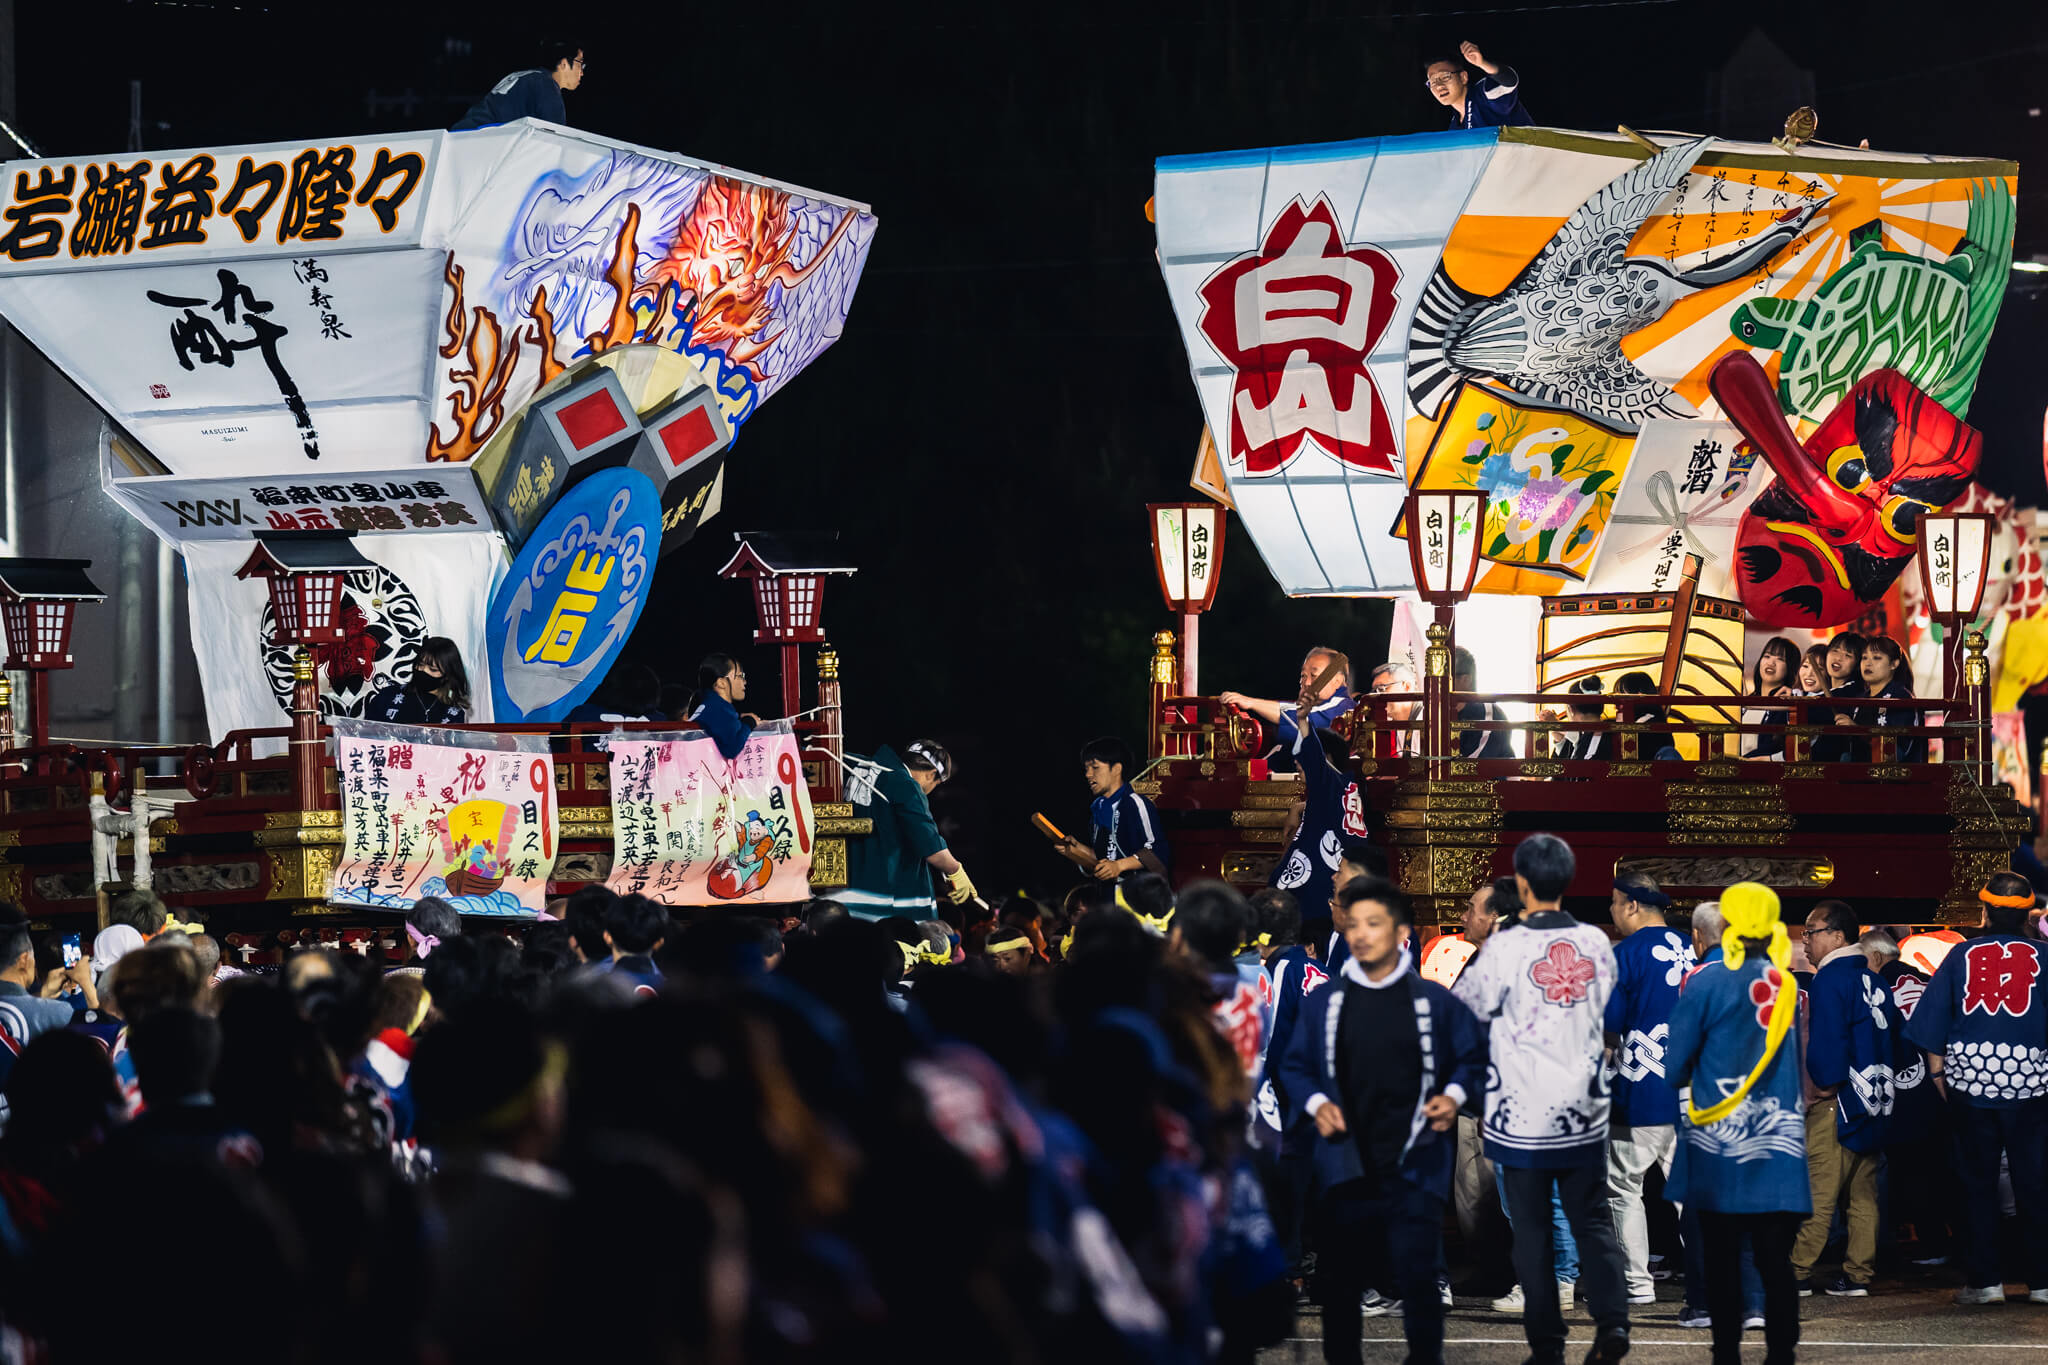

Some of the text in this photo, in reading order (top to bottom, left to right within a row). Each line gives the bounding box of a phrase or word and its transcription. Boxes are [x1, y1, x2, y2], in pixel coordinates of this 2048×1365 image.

[0, 145, 426, 262] 岩瀬益々隆々
[1234, 220, 1375, 451] 白山
[201, 426, 249, 436] MASUIZUMI
[1680, 438, 1723, 495] 献酒
[1191, 522, 1209, 581] 白山町
[1426, 508, 1444, 569] 白山町
[1933, 532, 1951, 588] 白山町
[386, 744, 414, 771] 贈
[452, 751, 488, 797] 祝
[468, 809, 484, 828] 宝
